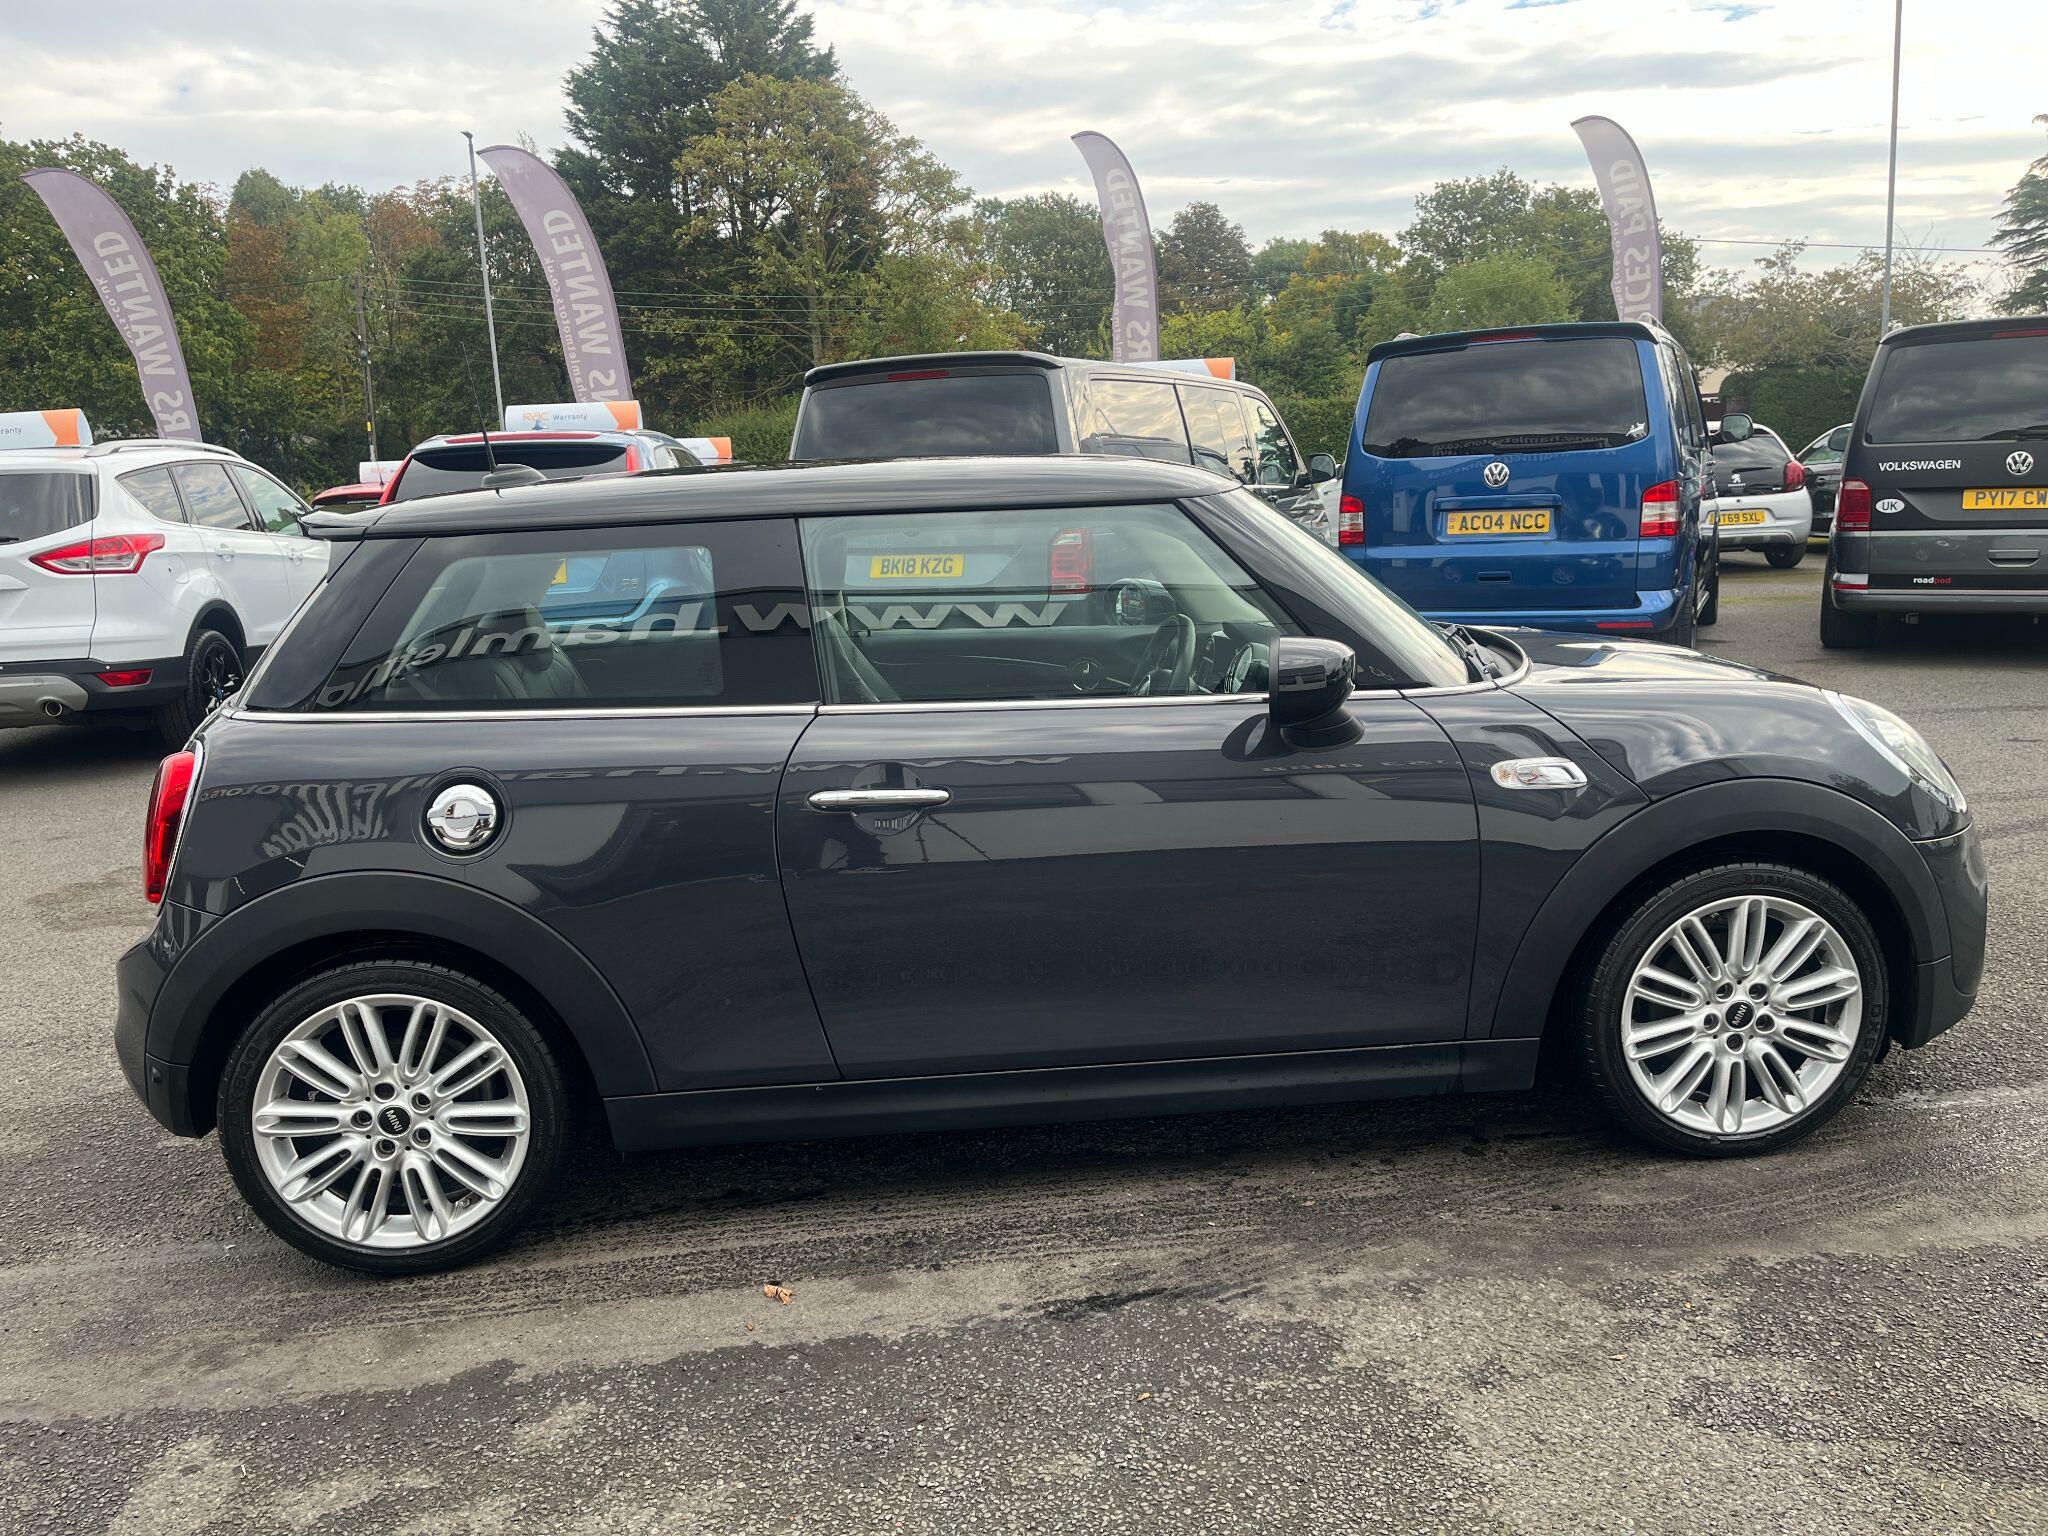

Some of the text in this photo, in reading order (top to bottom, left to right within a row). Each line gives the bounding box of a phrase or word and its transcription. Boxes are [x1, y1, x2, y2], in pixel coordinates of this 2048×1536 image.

[1878, 459, 1962, 471] VOLKSWAGEN
[1881, 501, 1898, 511] UK
[1975, 491, 2018, 505] PY17
[1459, 513, 1546, 531] AC04 NCC
[1742, 512, 1760, 522] SXL
[880, 557, 953, 575] BK18 KZG
[1731, 1004, 1748, 1026] MINI
[386, 1109, 403, 1132] MINI
